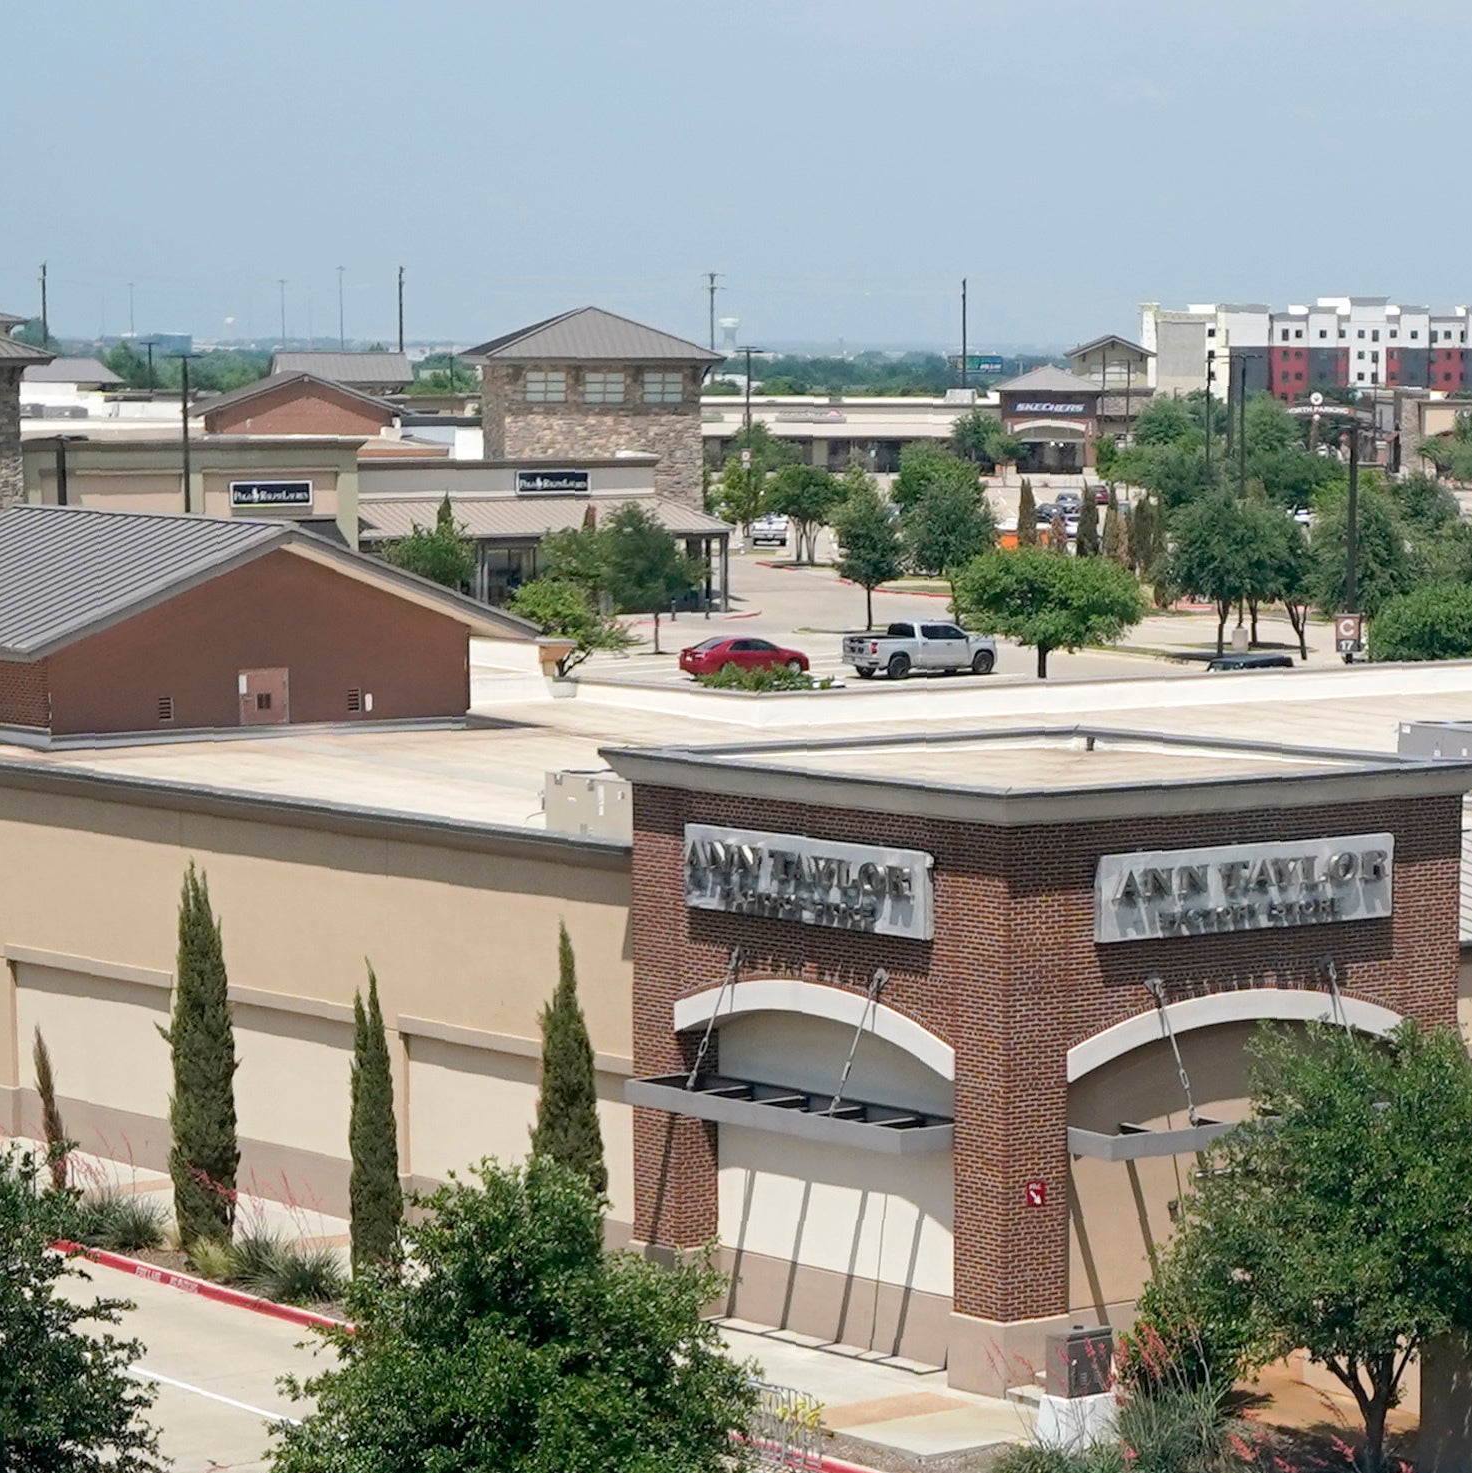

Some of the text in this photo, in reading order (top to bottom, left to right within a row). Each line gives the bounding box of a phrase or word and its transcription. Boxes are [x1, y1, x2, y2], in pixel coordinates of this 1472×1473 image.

[1015, 402, 1085, 412] SKECHERS
[1339, 619, 1355, 636] C
[1339, 640, 1355, 651] 17
[685, 839, 914, 898] ANN TAYLOR
[1111, 850, 1389, 904] ANN TAYLOR
